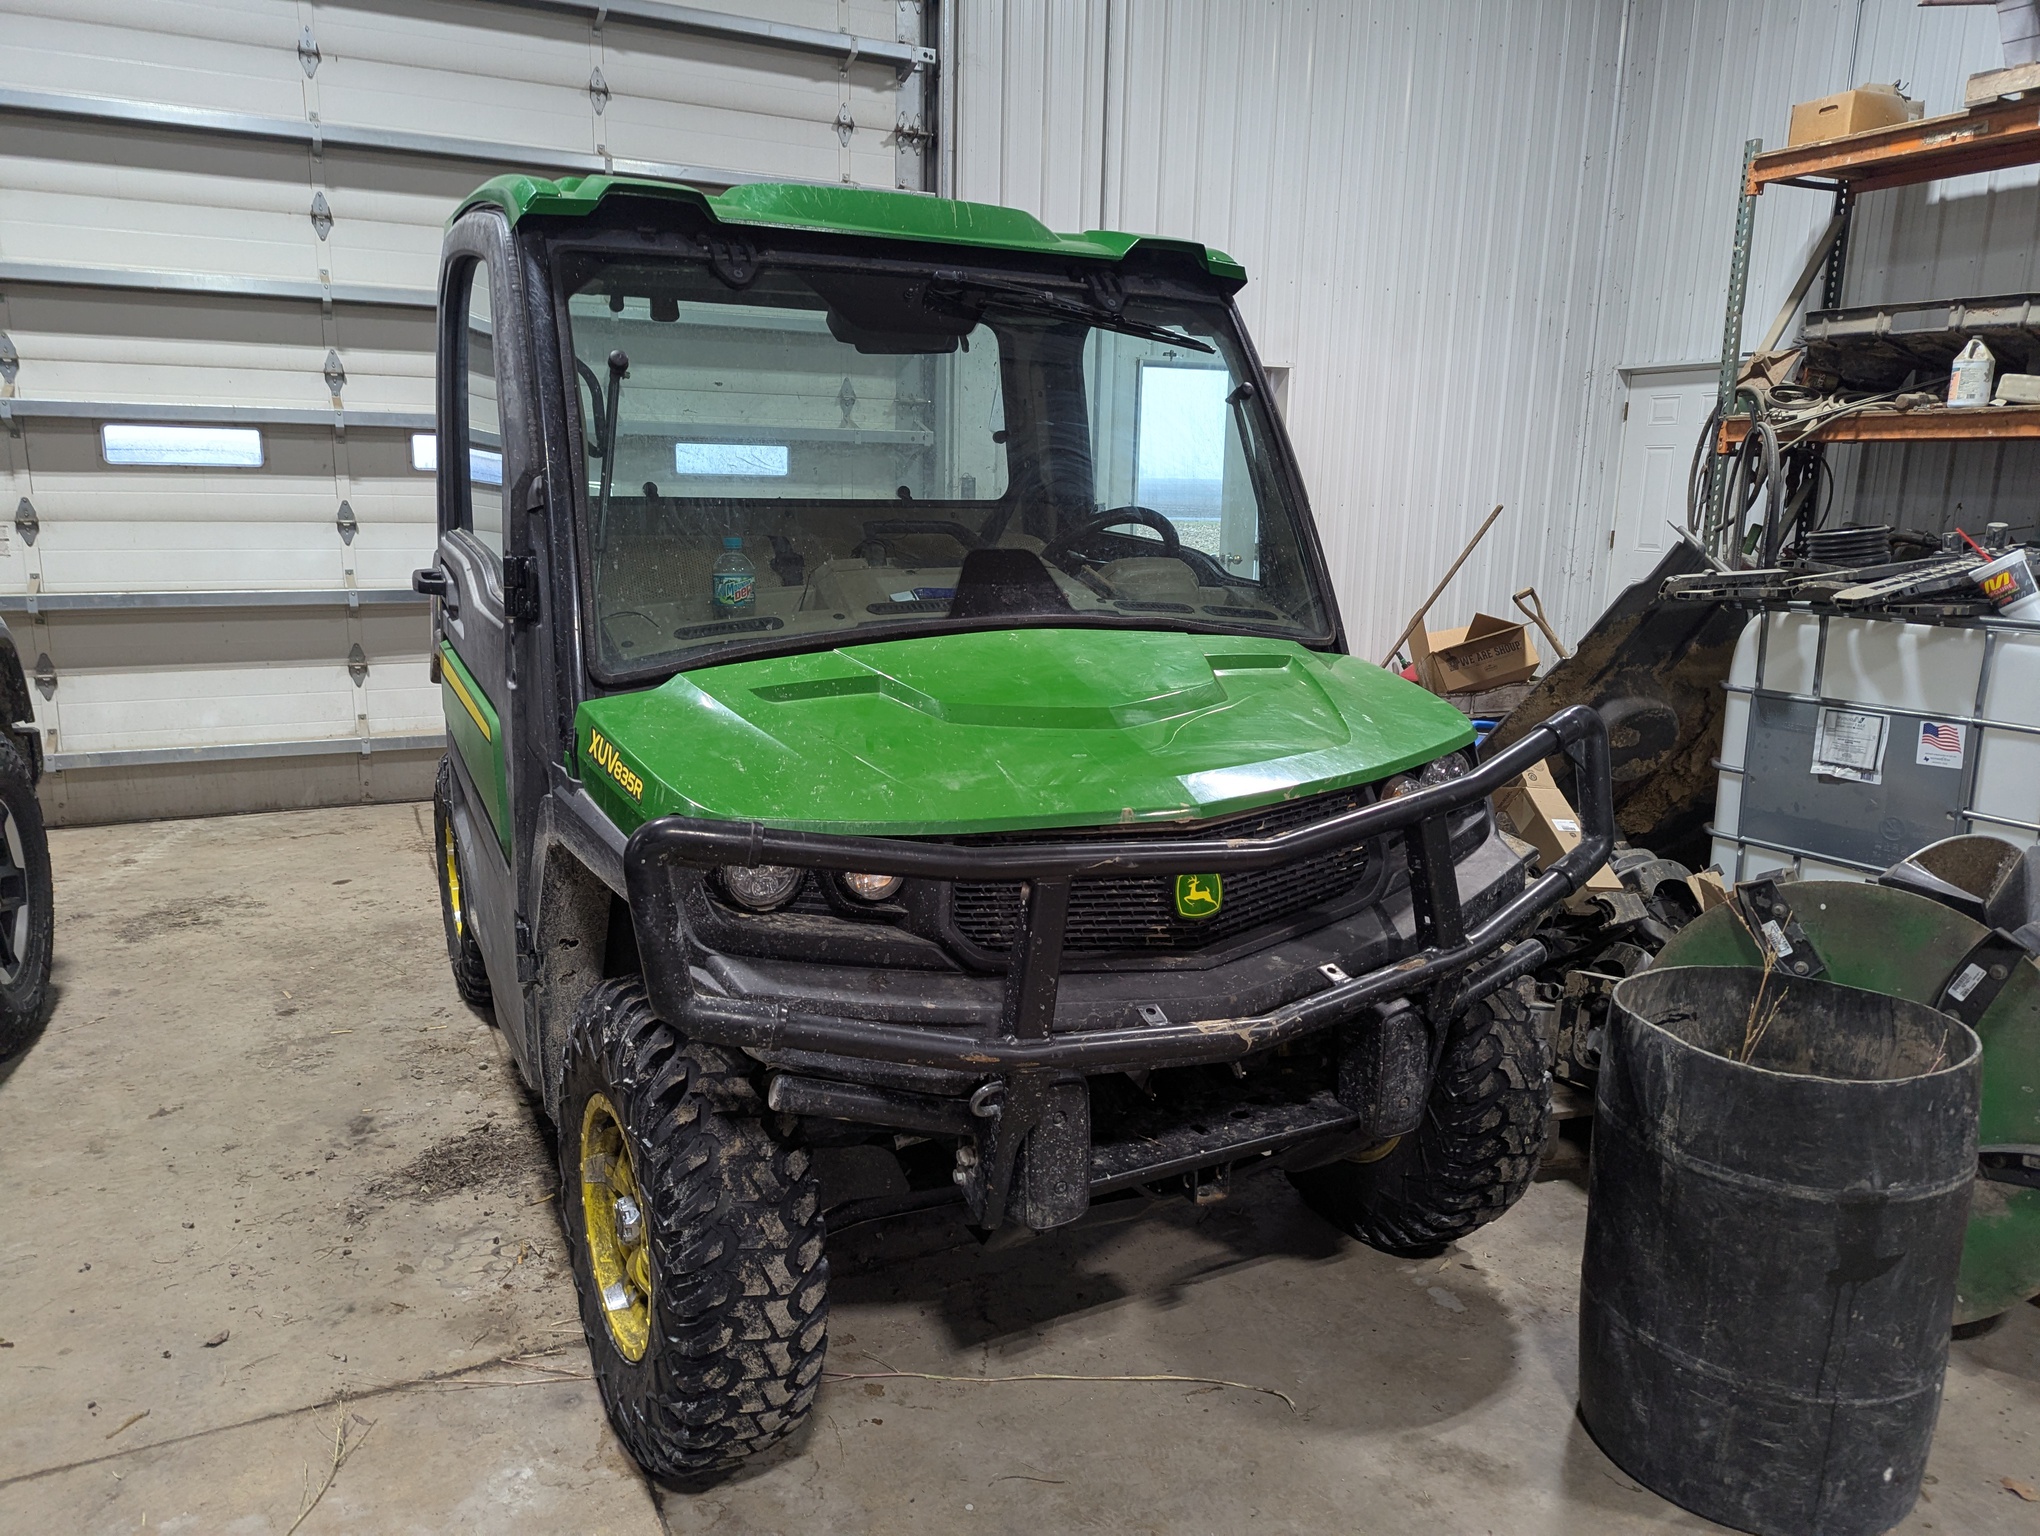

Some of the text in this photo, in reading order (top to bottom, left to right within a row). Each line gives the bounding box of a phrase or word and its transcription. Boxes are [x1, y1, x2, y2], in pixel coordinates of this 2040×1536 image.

[1460, 655, 1475, 667] WE
[1476, 649, 1493, 662] ARE
[588, 728, 643, 800] XUV835R
